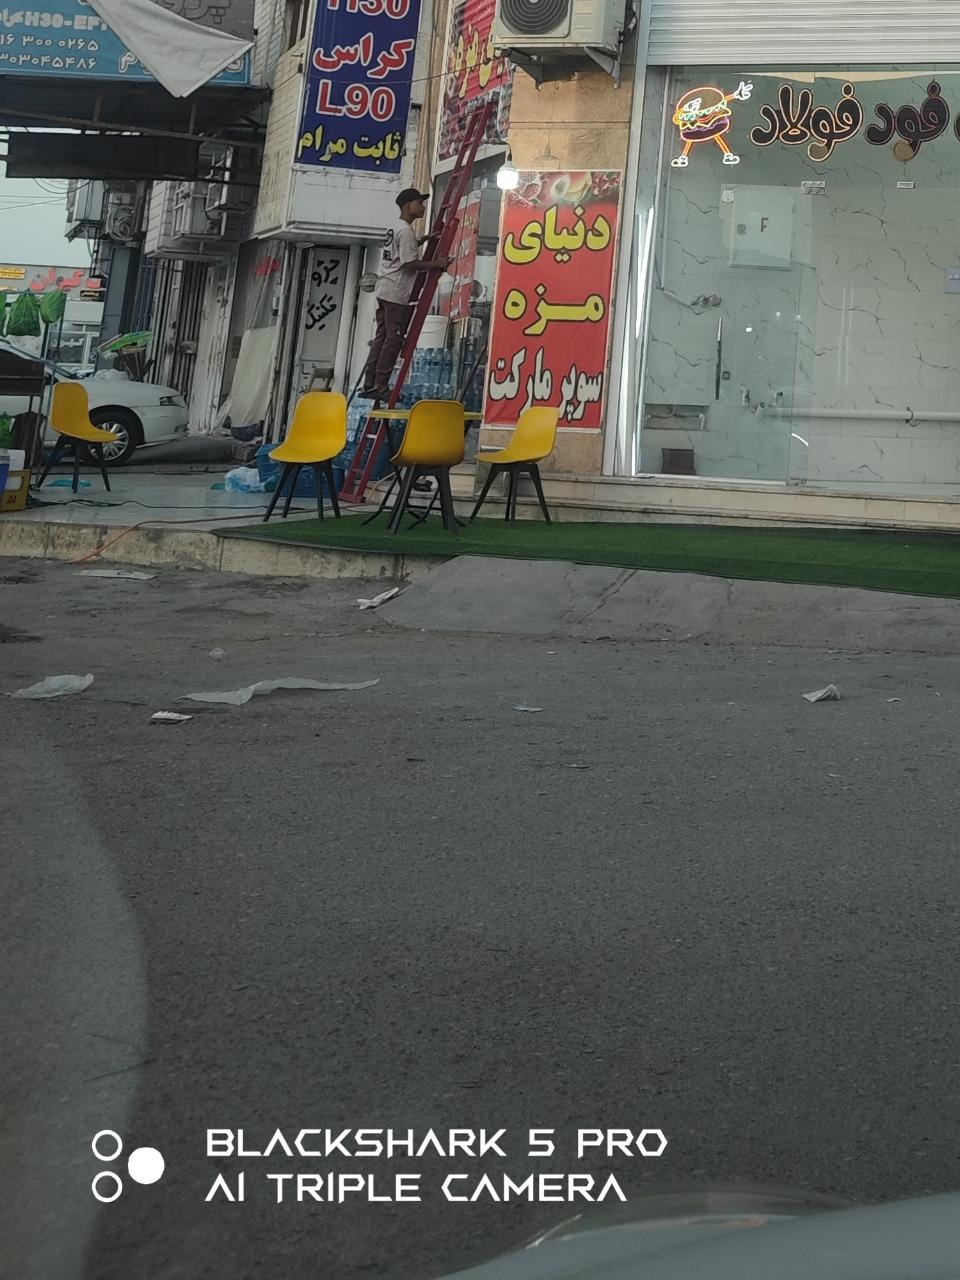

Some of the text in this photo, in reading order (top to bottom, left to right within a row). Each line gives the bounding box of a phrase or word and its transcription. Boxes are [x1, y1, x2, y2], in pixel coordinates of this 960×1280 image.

[313, 31, 415, 80] کراس
[315, 79, 396, 122] L90
[748, 80, 863, 162] فولاد
[865, 80, 951, 162] فود
[297, 124, 402, 166] ثابت مرام
[503, 203, 612, 266] دنیای
[504, 282, 605, 337] مزه
[488, 345, 603, 424] سوپر مارکت
